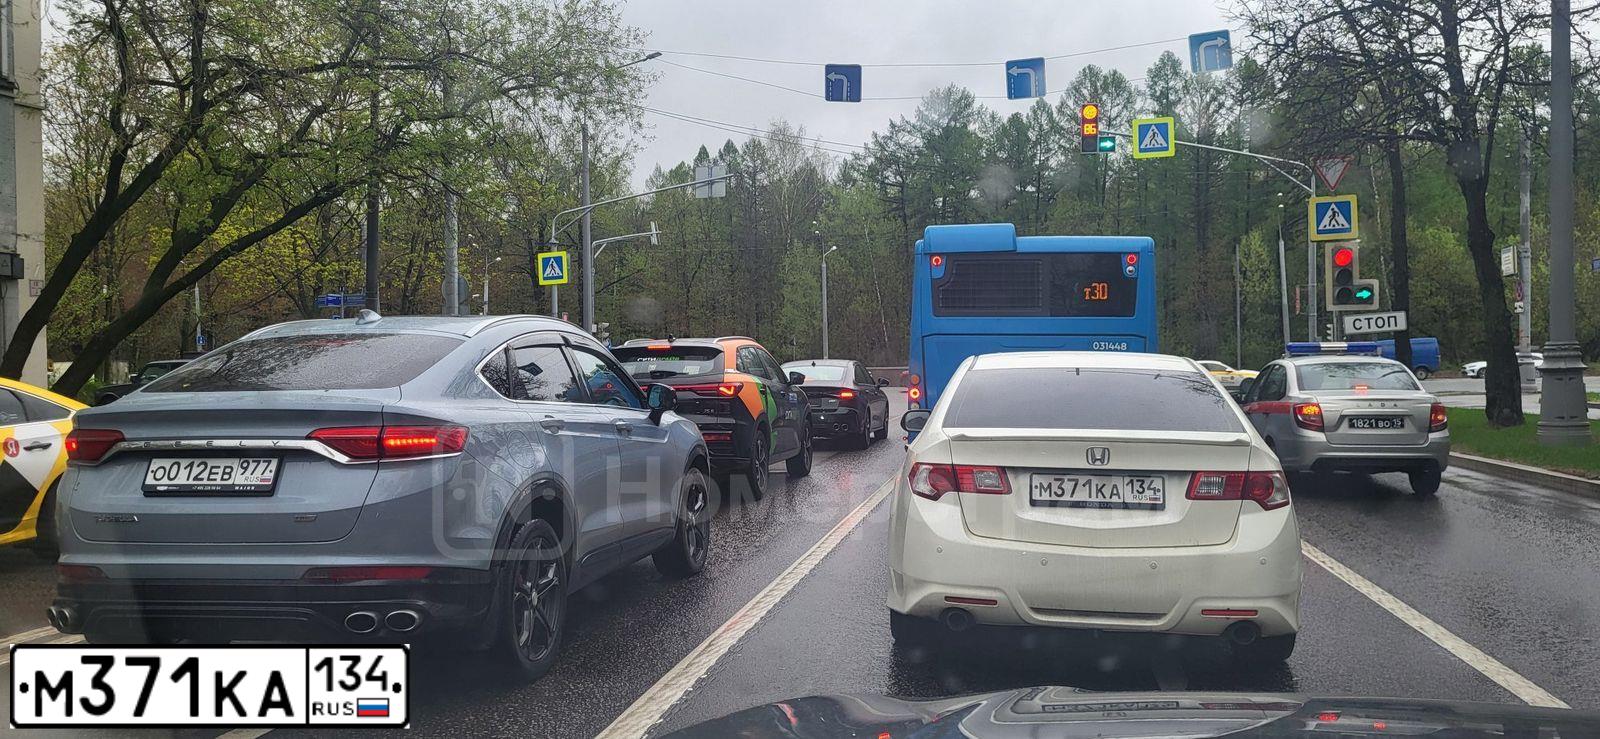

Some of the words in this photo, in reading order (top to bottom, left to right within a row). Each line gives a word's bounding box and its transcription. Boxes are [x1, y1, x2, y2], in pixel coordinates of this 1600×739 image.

[1352, 315, 1398, 331] СТОП
[1092, 341, 1127, 351] 031448
[143, 440, 280, 448] GEELY
[152, 461, 235, 482] О012ЕВ
[240, 459, 273, 476] 977
[243, 475, 260, 483] RUS
[1039, 477, 1121, 499] М371КА
[1126, 478, 1157, 496] 134
